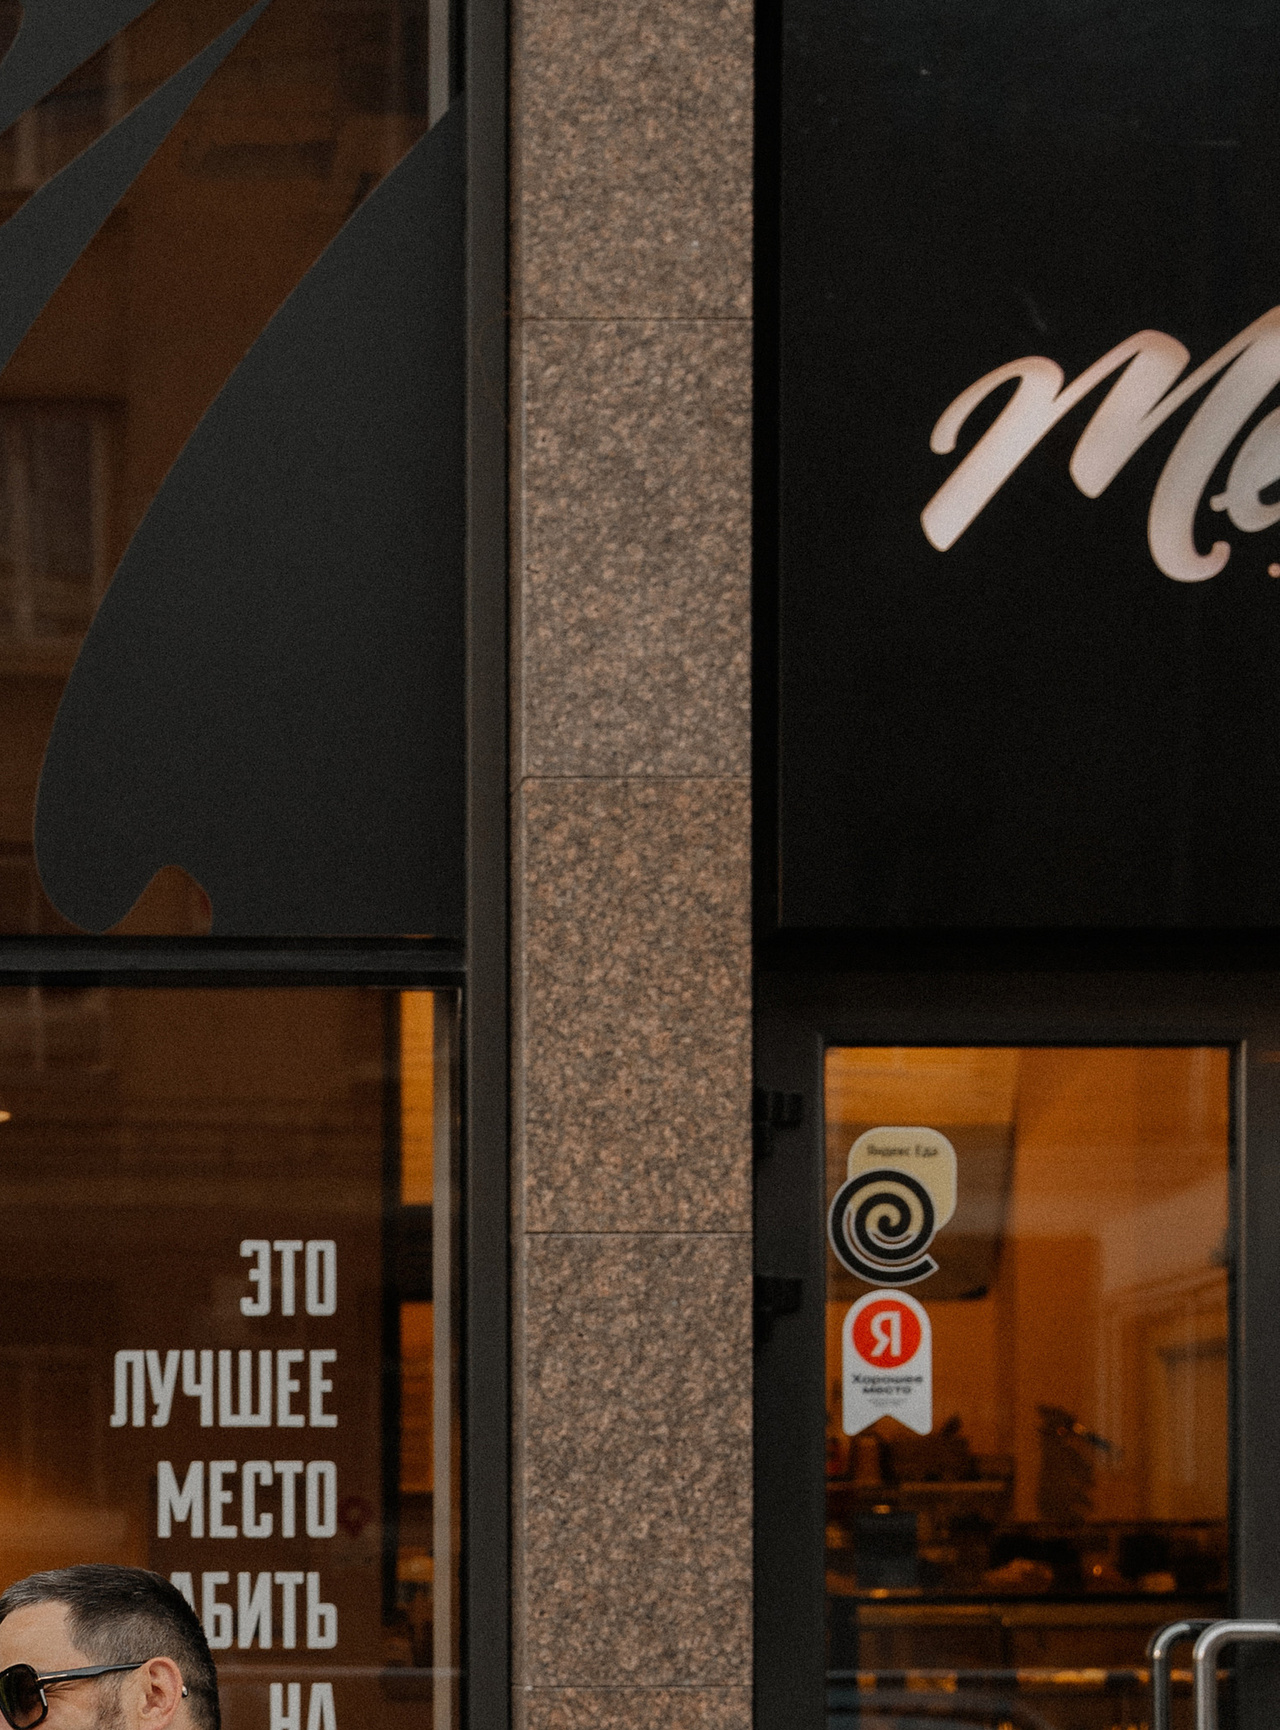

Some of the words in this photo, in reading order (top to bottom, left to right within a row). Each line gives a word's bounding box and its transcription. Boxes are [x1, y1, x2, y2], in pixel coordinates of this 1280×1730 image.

[239, 1239, 337, 1317] ЭТО
[110, 1349, 338, 1428] ЛУЧШЕЕ
[851, 1373, 923, 1385] Хорошее
[157, 1460, 338, 1539] МЕСТО
